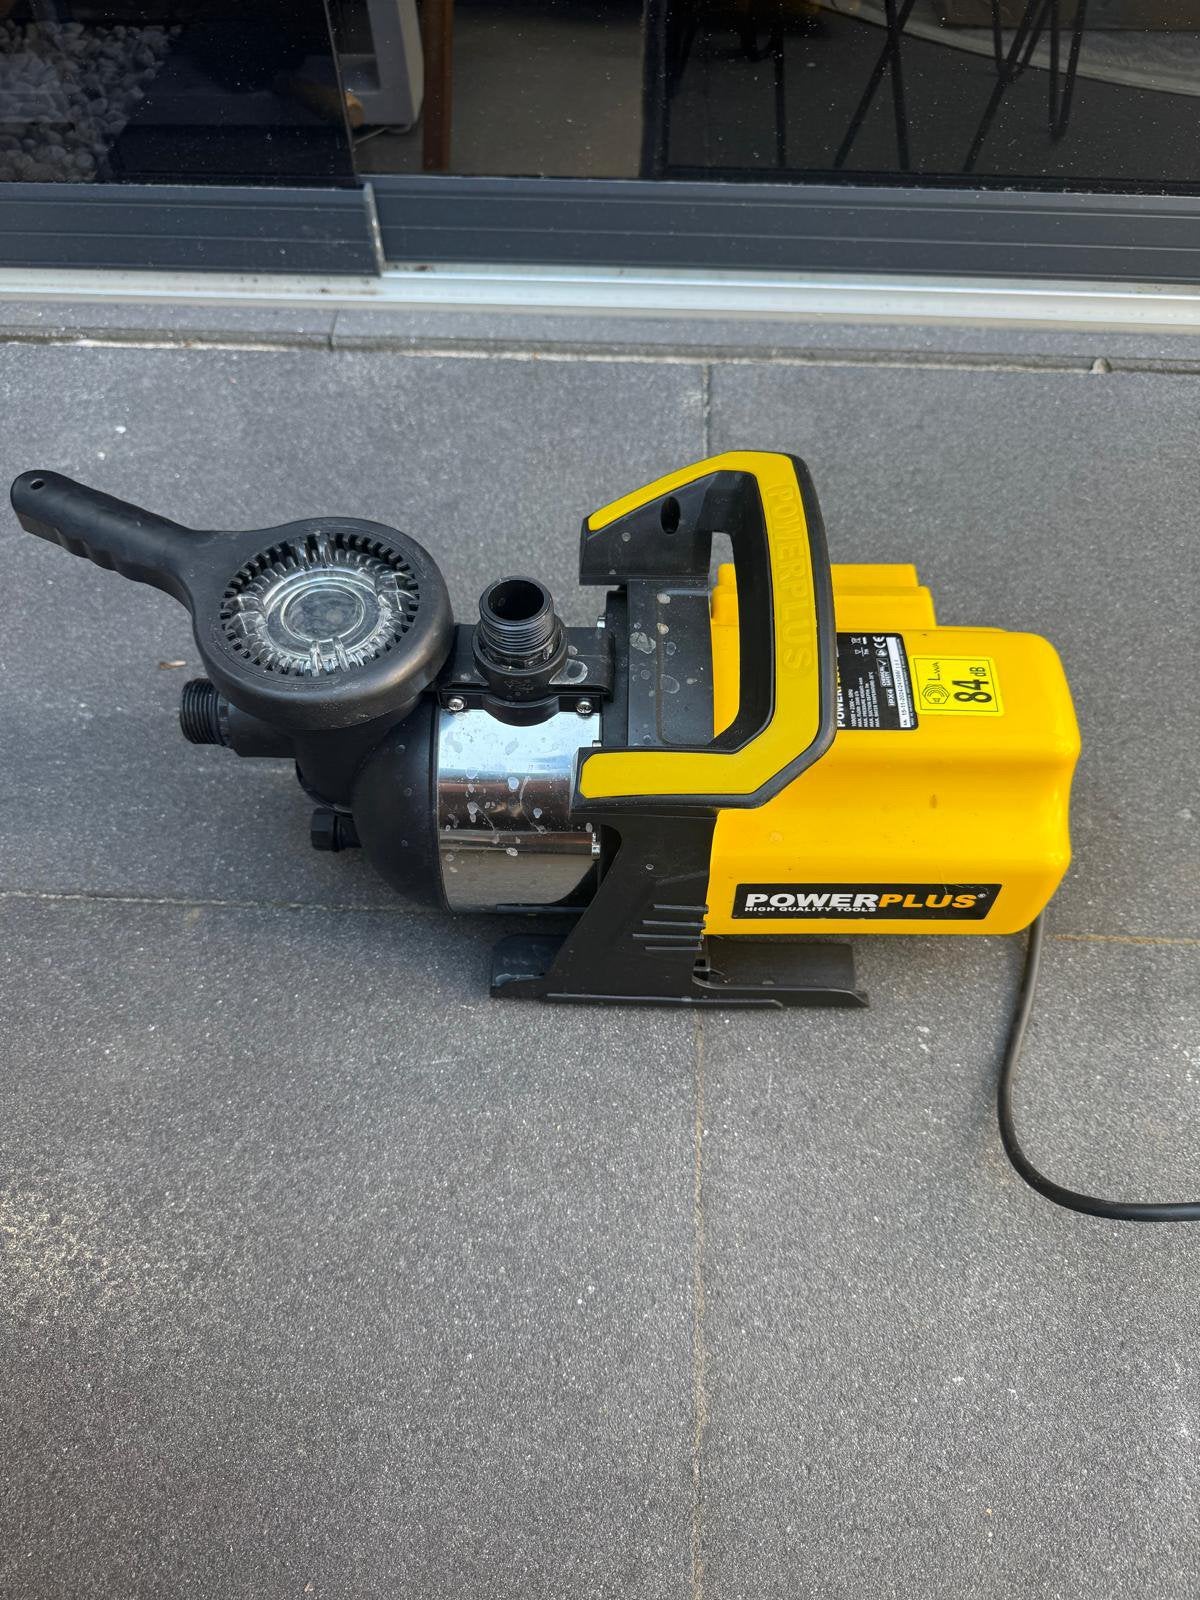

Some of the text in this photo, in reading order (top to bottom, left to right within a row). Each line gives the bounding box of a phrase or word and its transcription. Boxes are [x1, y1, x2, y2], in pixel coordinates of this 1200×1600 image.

[766, 487, 812, 670] POWERPLUS
[952, 667, 992, 703] 84 dB
